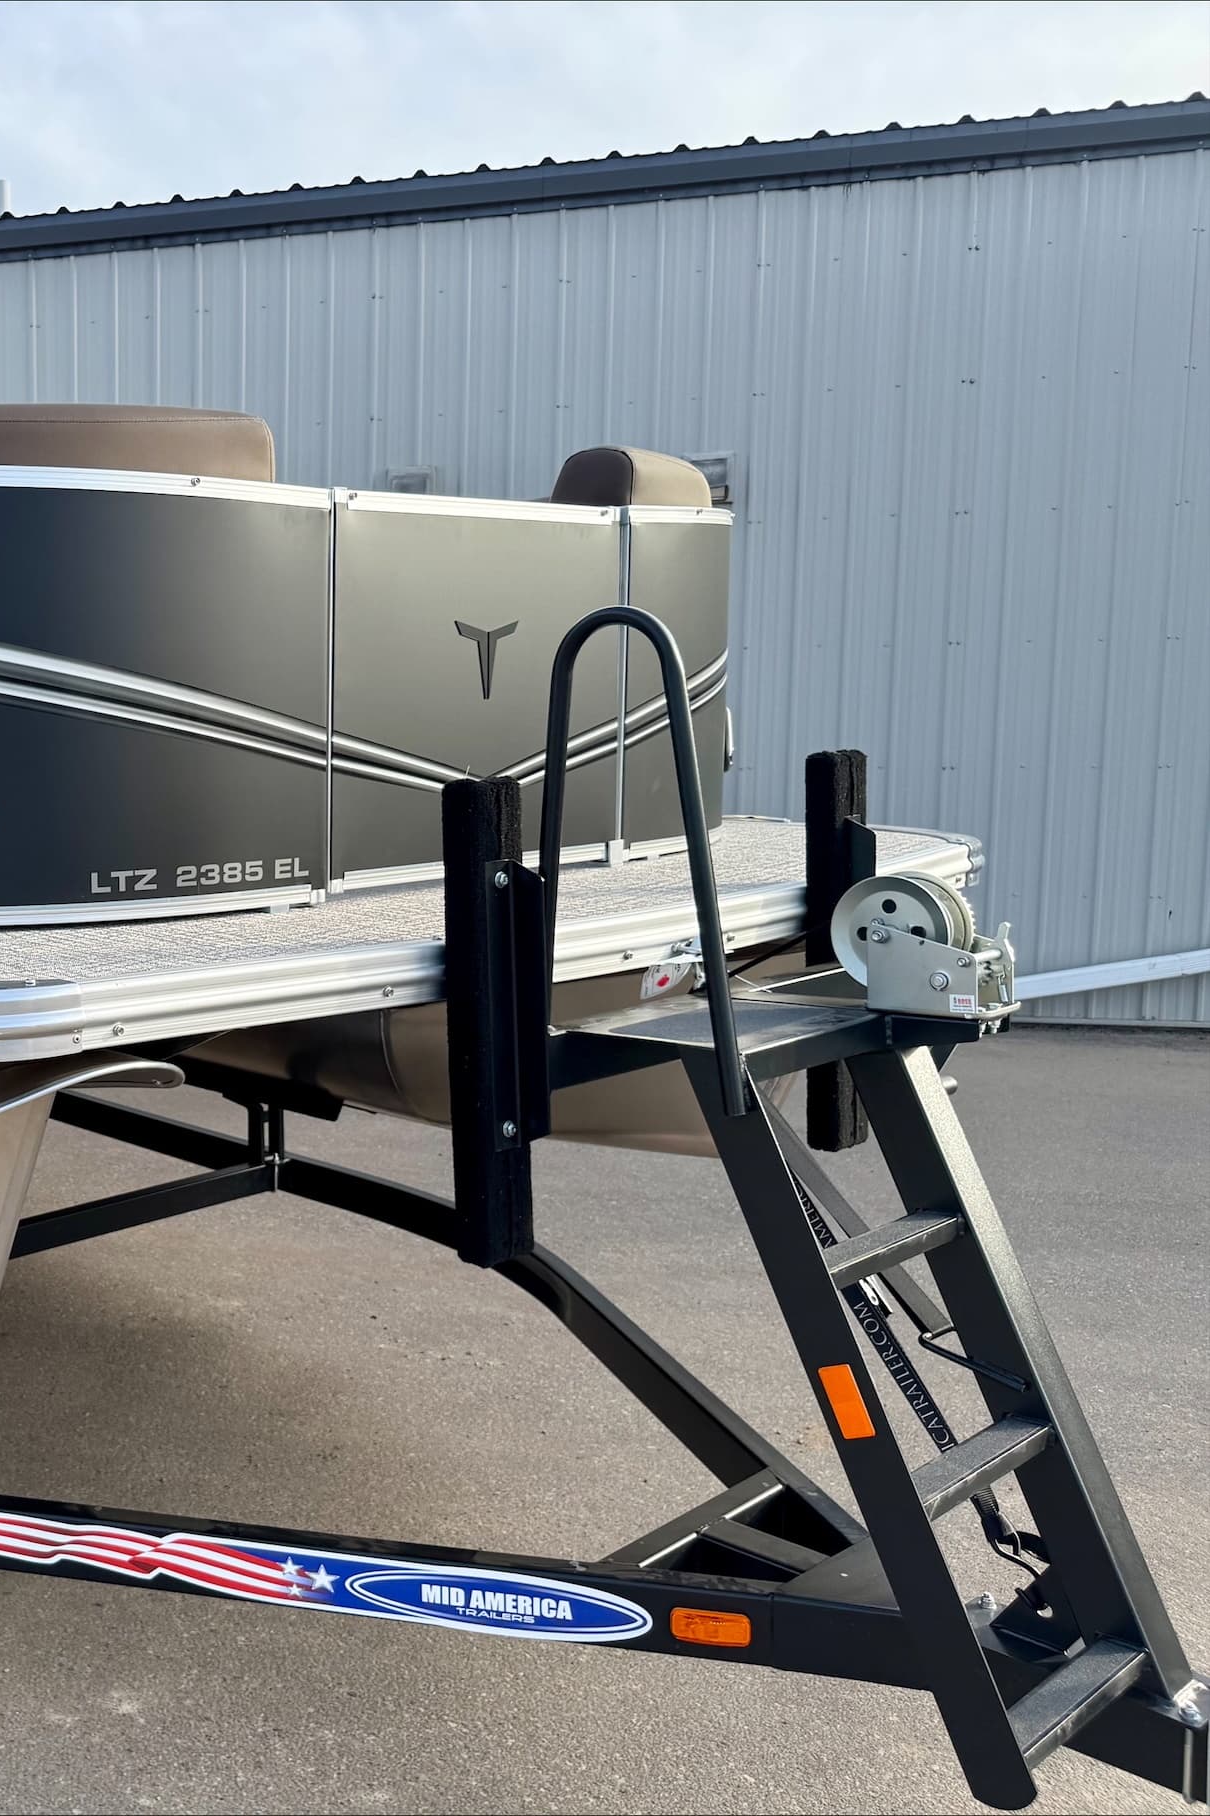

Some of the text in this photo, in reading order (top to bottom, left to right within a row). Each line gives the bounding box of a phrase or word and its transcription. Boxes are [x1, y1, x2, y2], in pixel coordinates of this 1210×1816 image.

[90, 856, 310, 895] LTZ 2385 EL
[421, 1584, 574, 1621] MID AMERICA
[455, 1606, 536, 1624] TRAILERS
